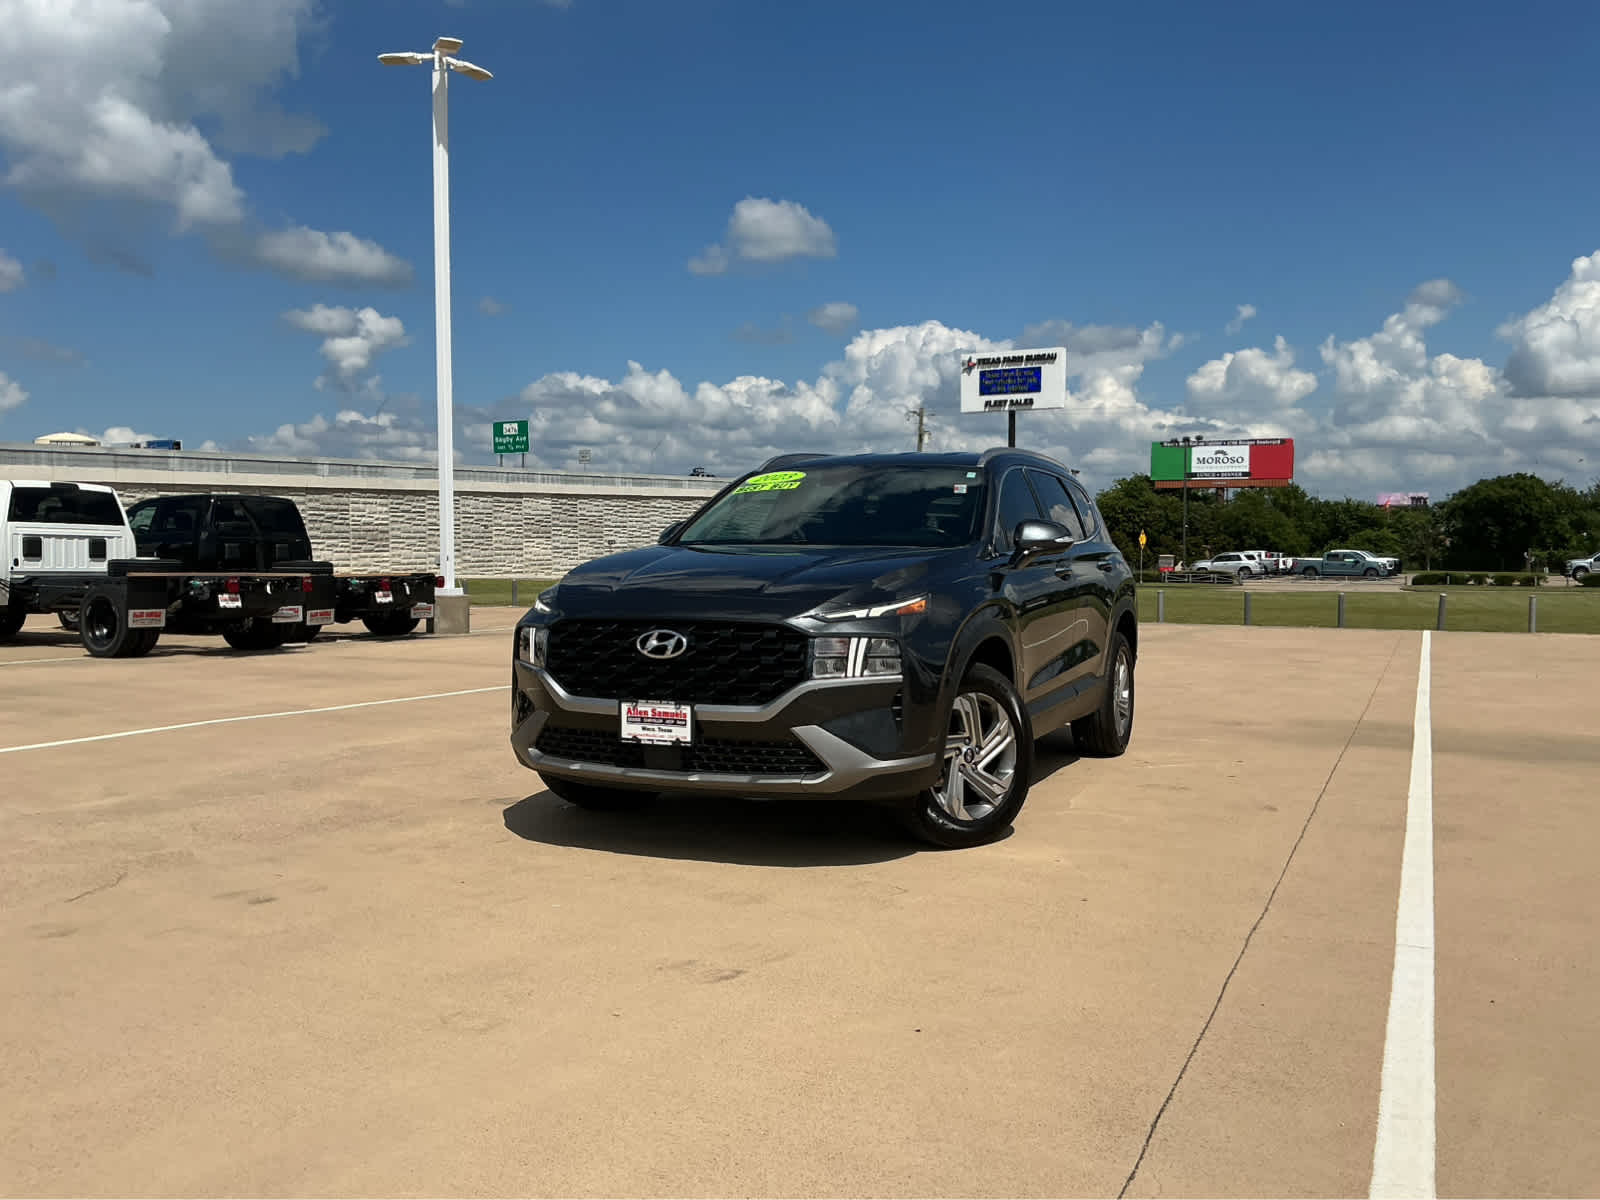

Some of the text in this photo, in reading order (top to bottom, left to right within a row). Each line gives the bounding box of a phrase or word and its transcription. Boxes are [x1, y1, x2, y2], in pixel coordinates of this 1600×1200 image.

[976, 352, 1057, 367] TEXAS FARM BUREAU
[984, 398, 1034, 409] FLEET SALES
[515, 435, 527, 443] Ave
[1196, 455, 1245, 465] MOROSO
[627, 707, 687, 719] Allen Samuels
